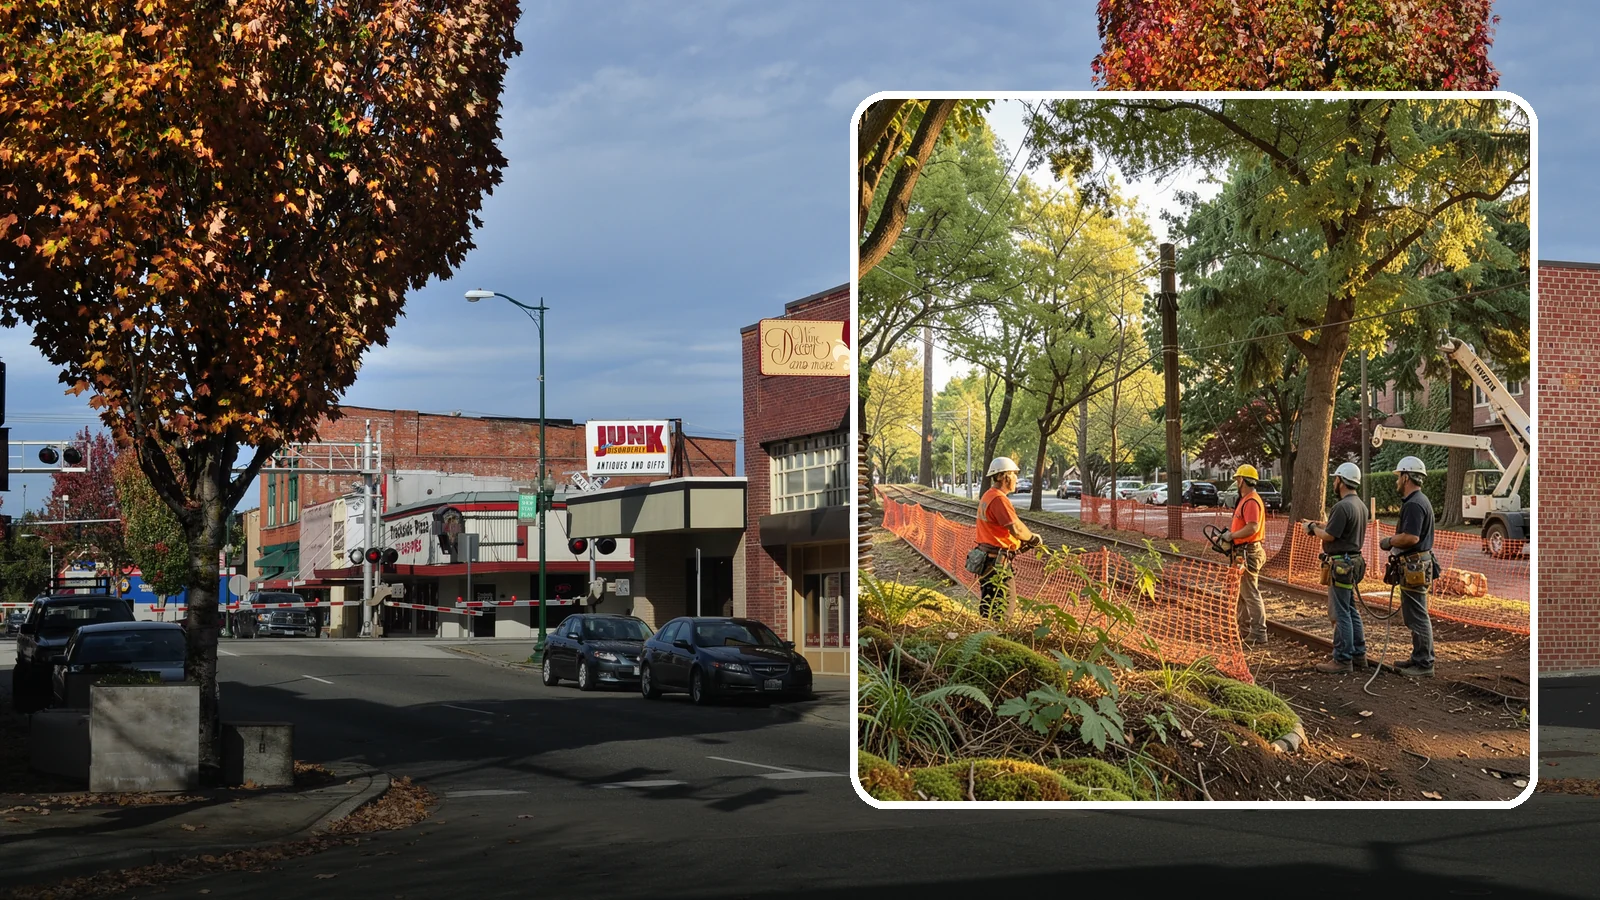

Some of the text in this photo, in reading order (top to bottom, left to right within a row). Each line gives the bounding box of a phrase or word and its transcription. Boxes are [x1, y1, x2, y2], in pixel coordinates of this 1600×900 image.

[595, 425, 665, 457] JUNK
[607, 446, 646, 454] DISORDERLY
[597, 460, 665, 470] ANTIQUES AND GIFTS
[573, 473, 589, 492] RAIL
